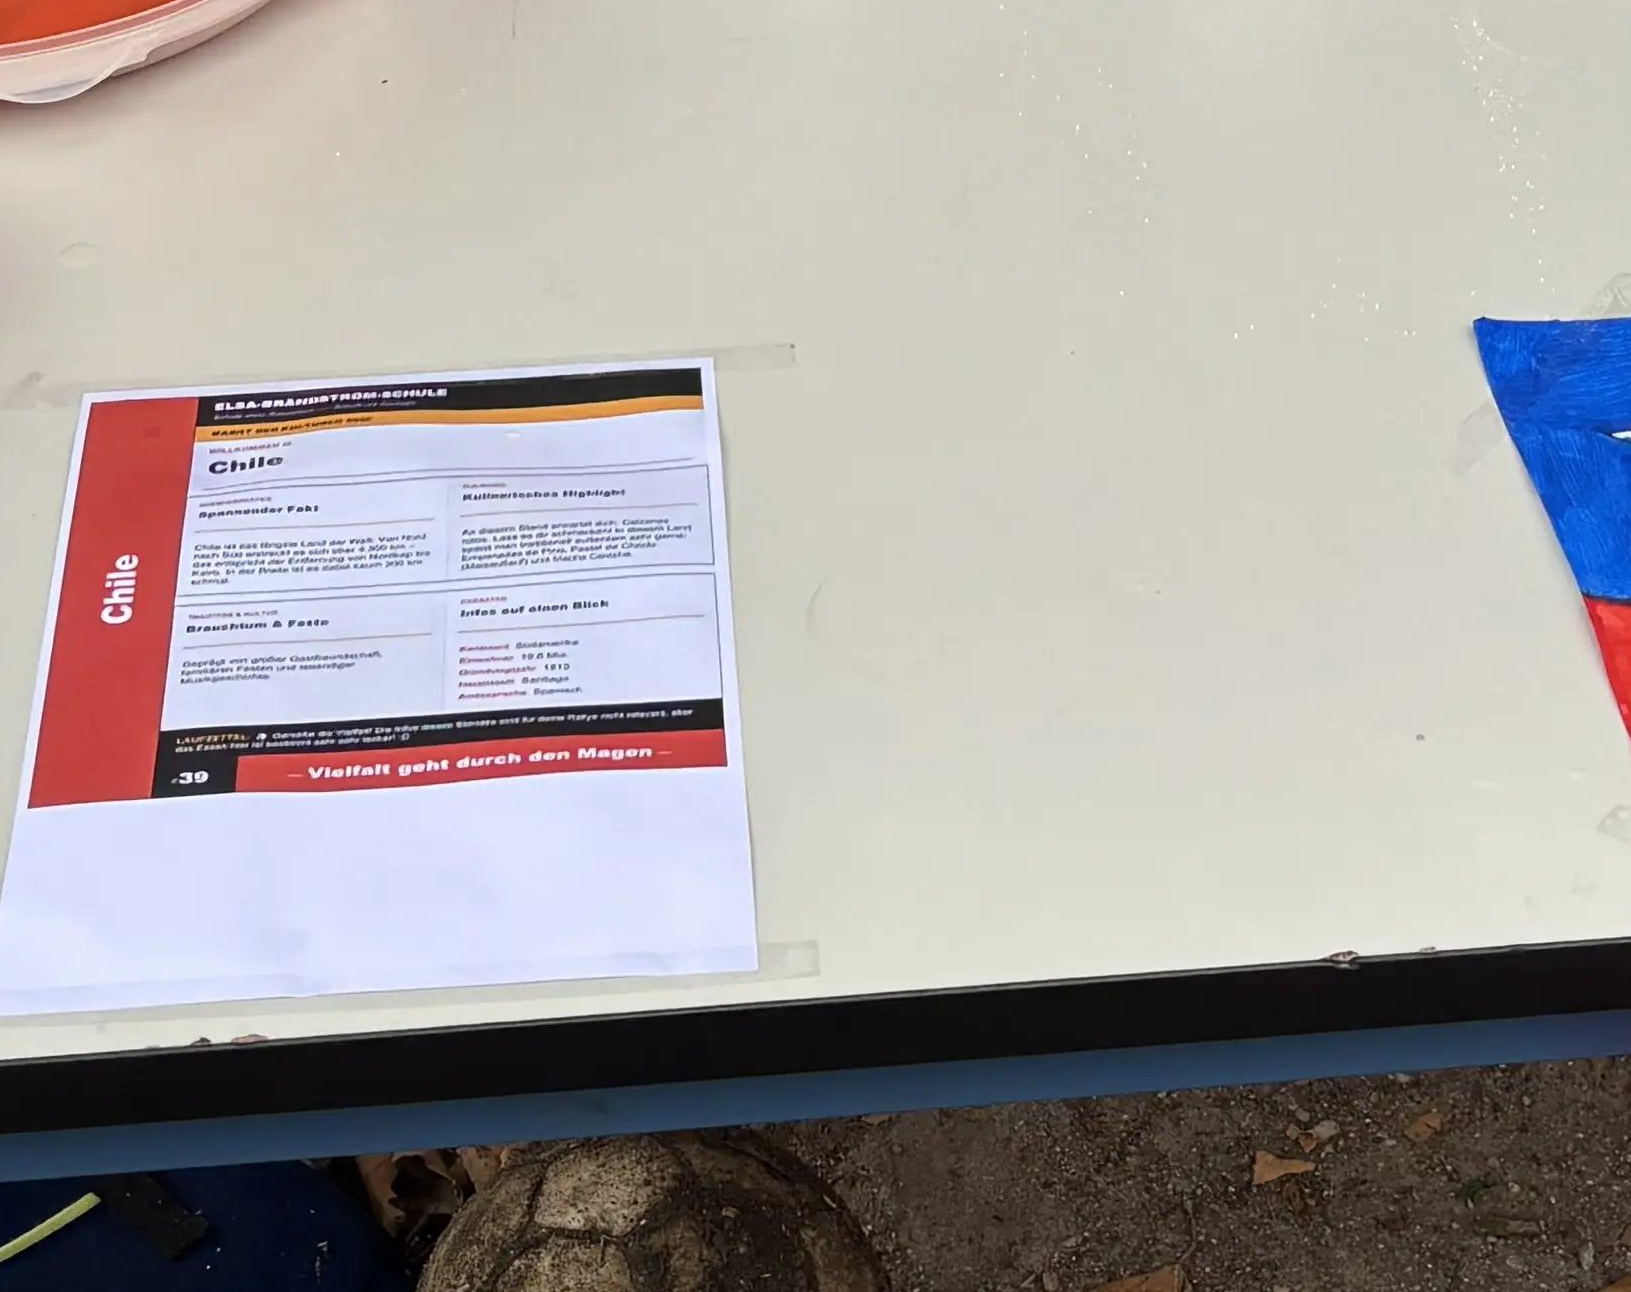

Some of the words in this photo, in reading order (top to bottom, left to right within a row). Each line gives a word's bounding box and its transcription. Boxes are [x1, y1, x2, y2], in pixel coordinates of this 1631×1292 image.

[208, 455, 284, 475] Chile
[99, 552, 139, 626] Chile
[307, 761, 391, 780] Vielfalt
[398, 758, 449, 777] geht
[456, 750, 521, 769] durch
[528, 748, 570, 763] den
[577, 746, 653, 761] Magen
